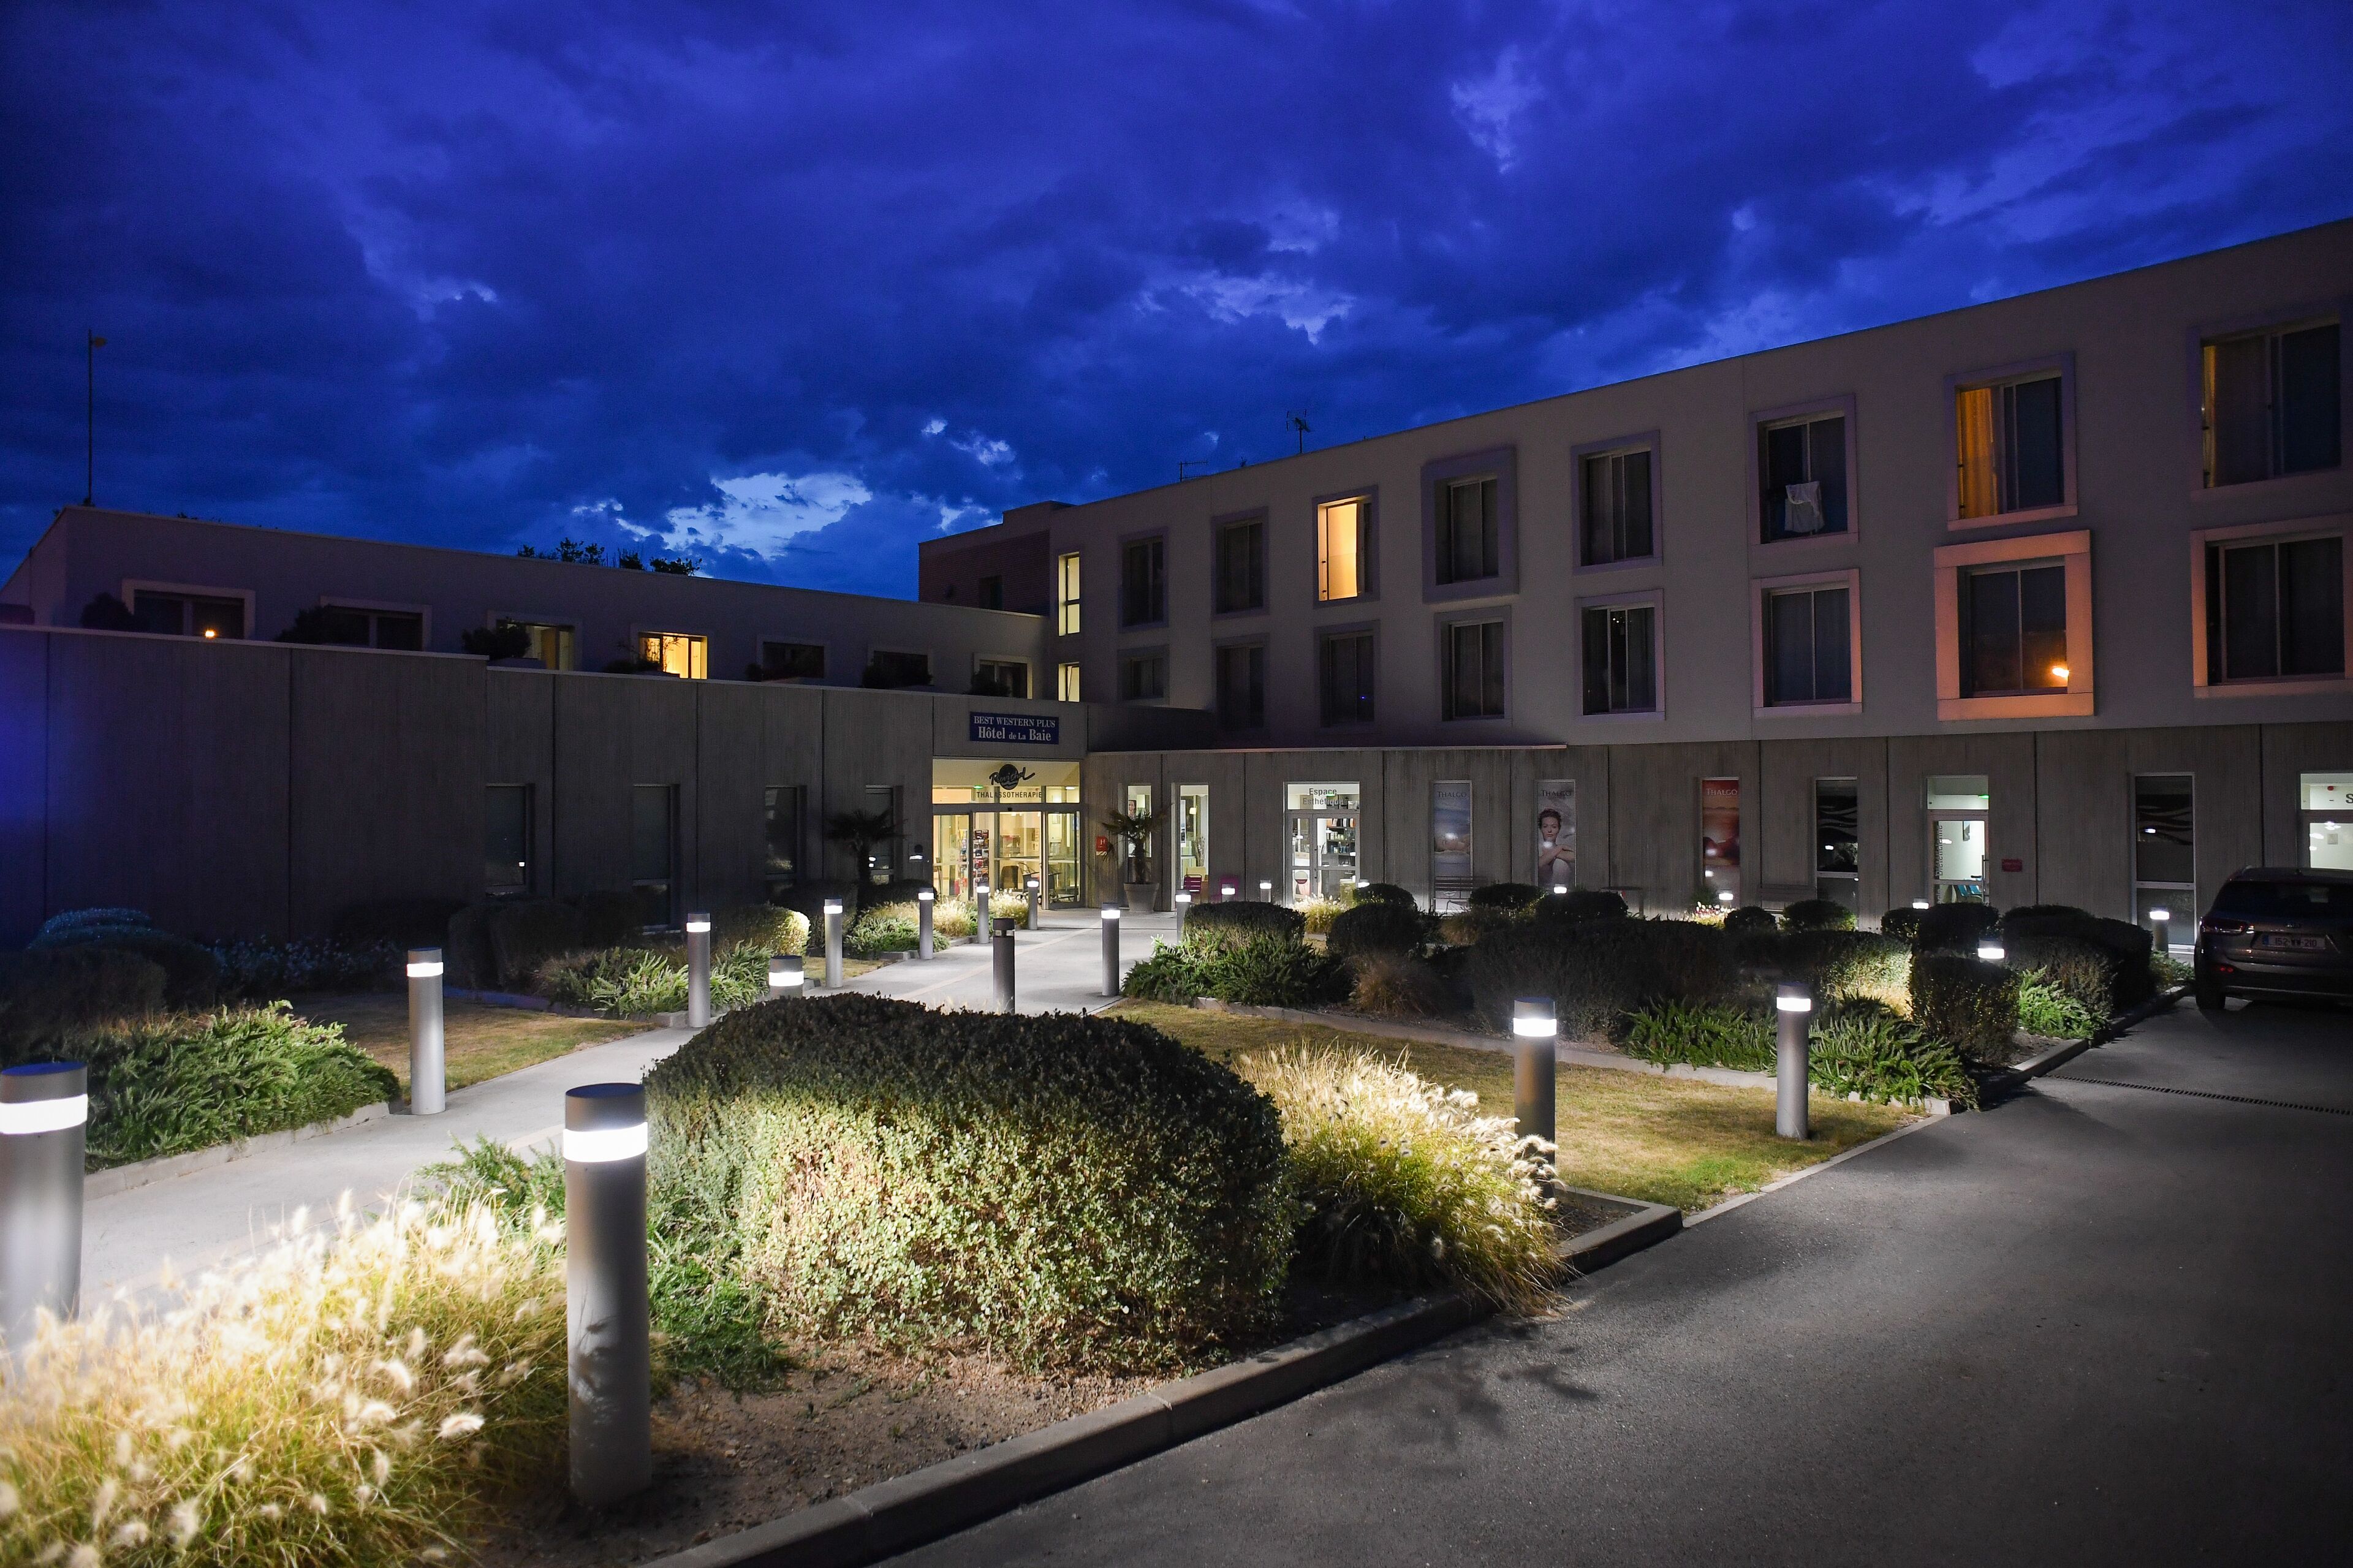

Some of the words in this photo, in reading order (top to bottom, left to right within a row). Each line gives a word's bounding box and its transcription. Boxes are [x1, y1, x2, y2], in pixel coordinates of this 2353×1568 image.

[974, 716, 995, 725] BEST
[996, 717, 1034, 727] WESTERN
[1037, 719, 1055, 728] PLUS
[978, 726, 1006, 739] Hôtel
[1029, 729, 1051, 741] Baie
